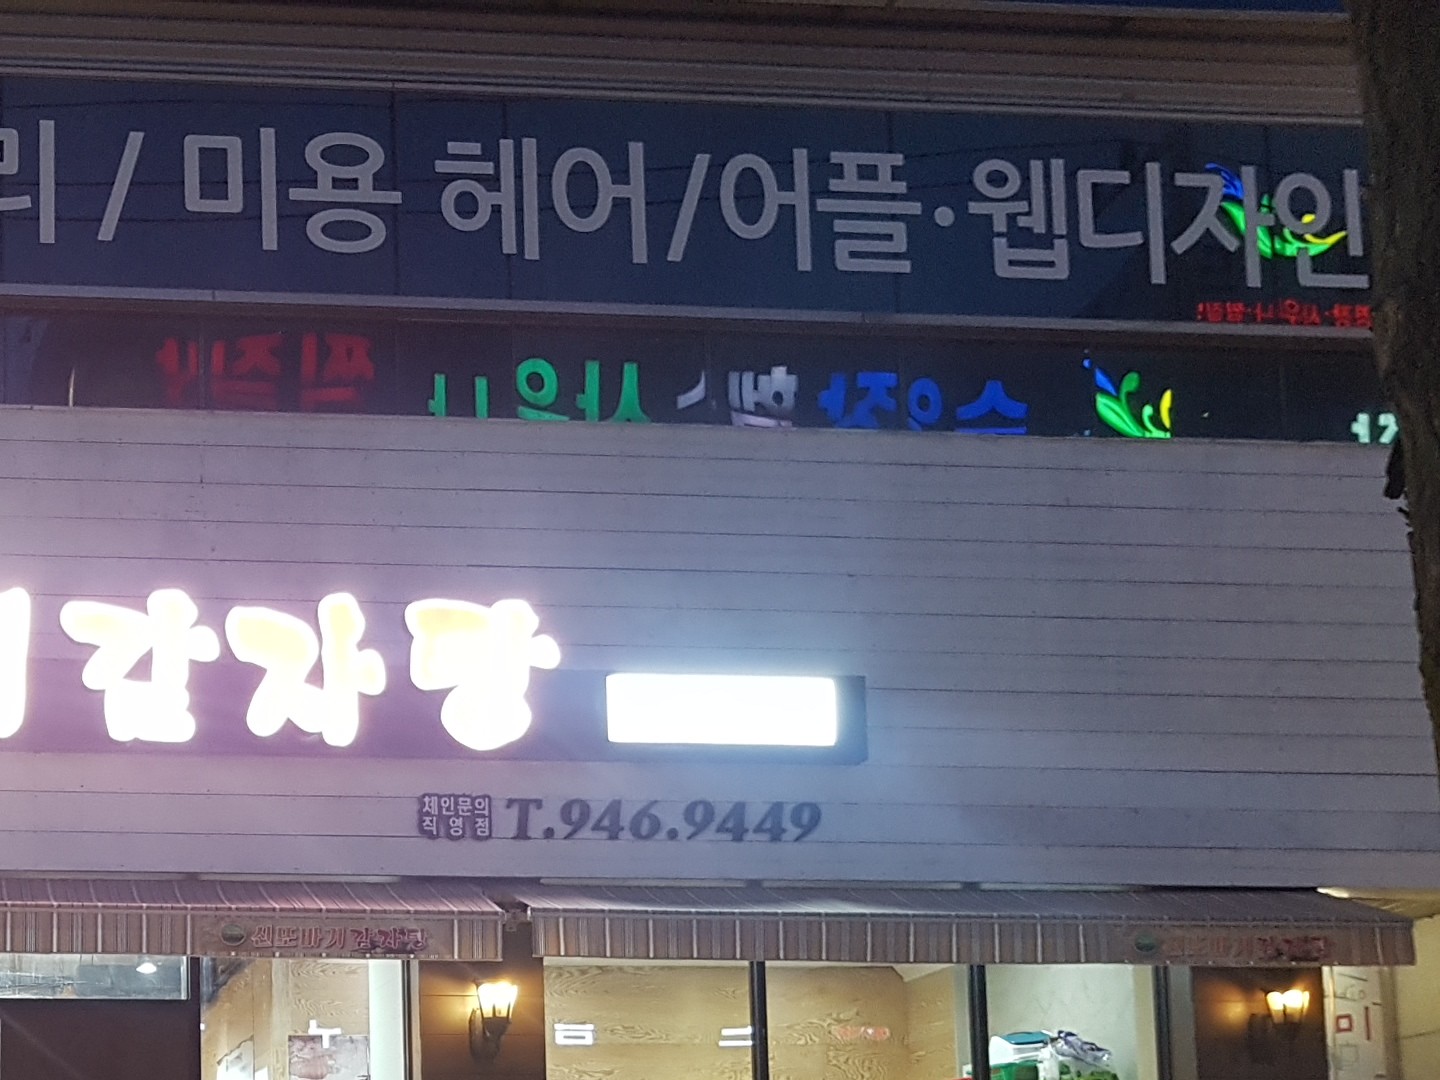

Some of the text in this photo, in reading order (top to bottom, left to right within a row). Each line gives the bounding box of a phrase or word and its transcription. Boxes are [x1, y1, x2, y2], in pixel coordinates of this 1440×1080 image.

[183, 127, 402, 253] 미용
[59, 588, 561, 750] 감자탕
[422, 795, 491, 816] 체인문의
[505, 798, 822, 841] T.946.9449
